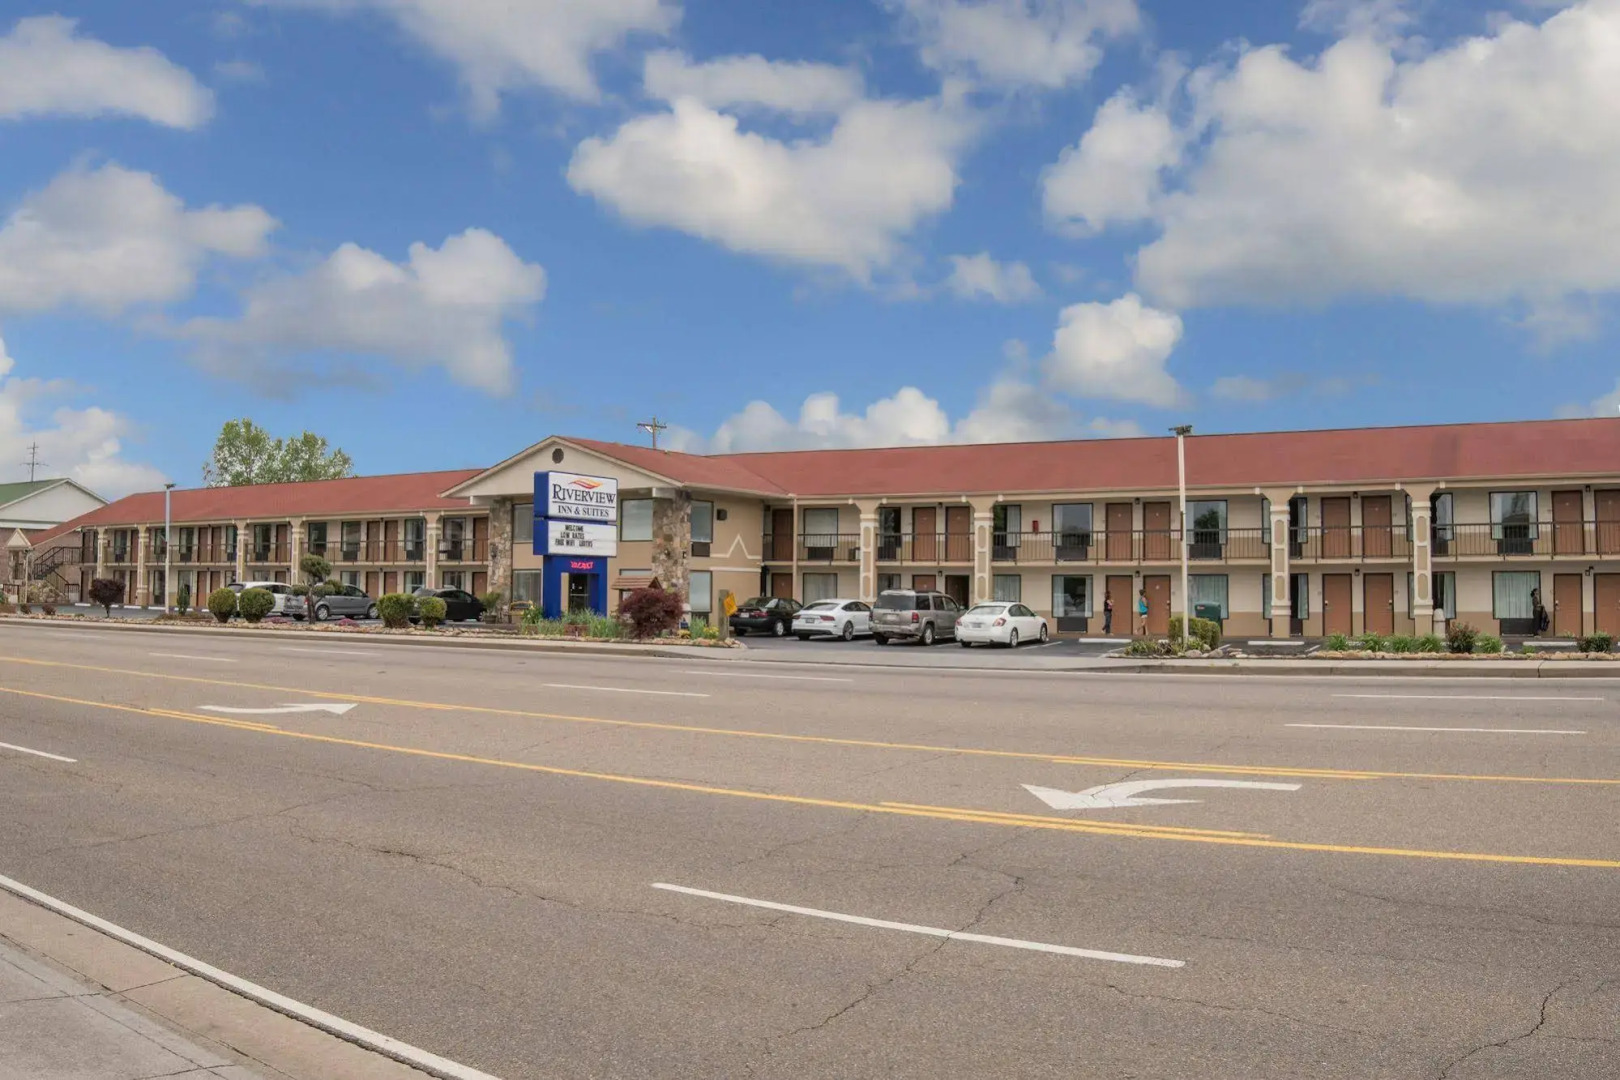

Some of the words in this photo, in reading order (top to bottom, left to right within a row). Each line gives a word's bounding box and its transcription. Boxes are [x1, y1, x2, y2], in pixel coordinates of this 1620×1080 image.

[552, 483, 616, 504] RIVERVIEW
[558, 505, 572, 514] INN
[574, 506, 580, 515] &
[582, 508, 609, 517] SUITES
